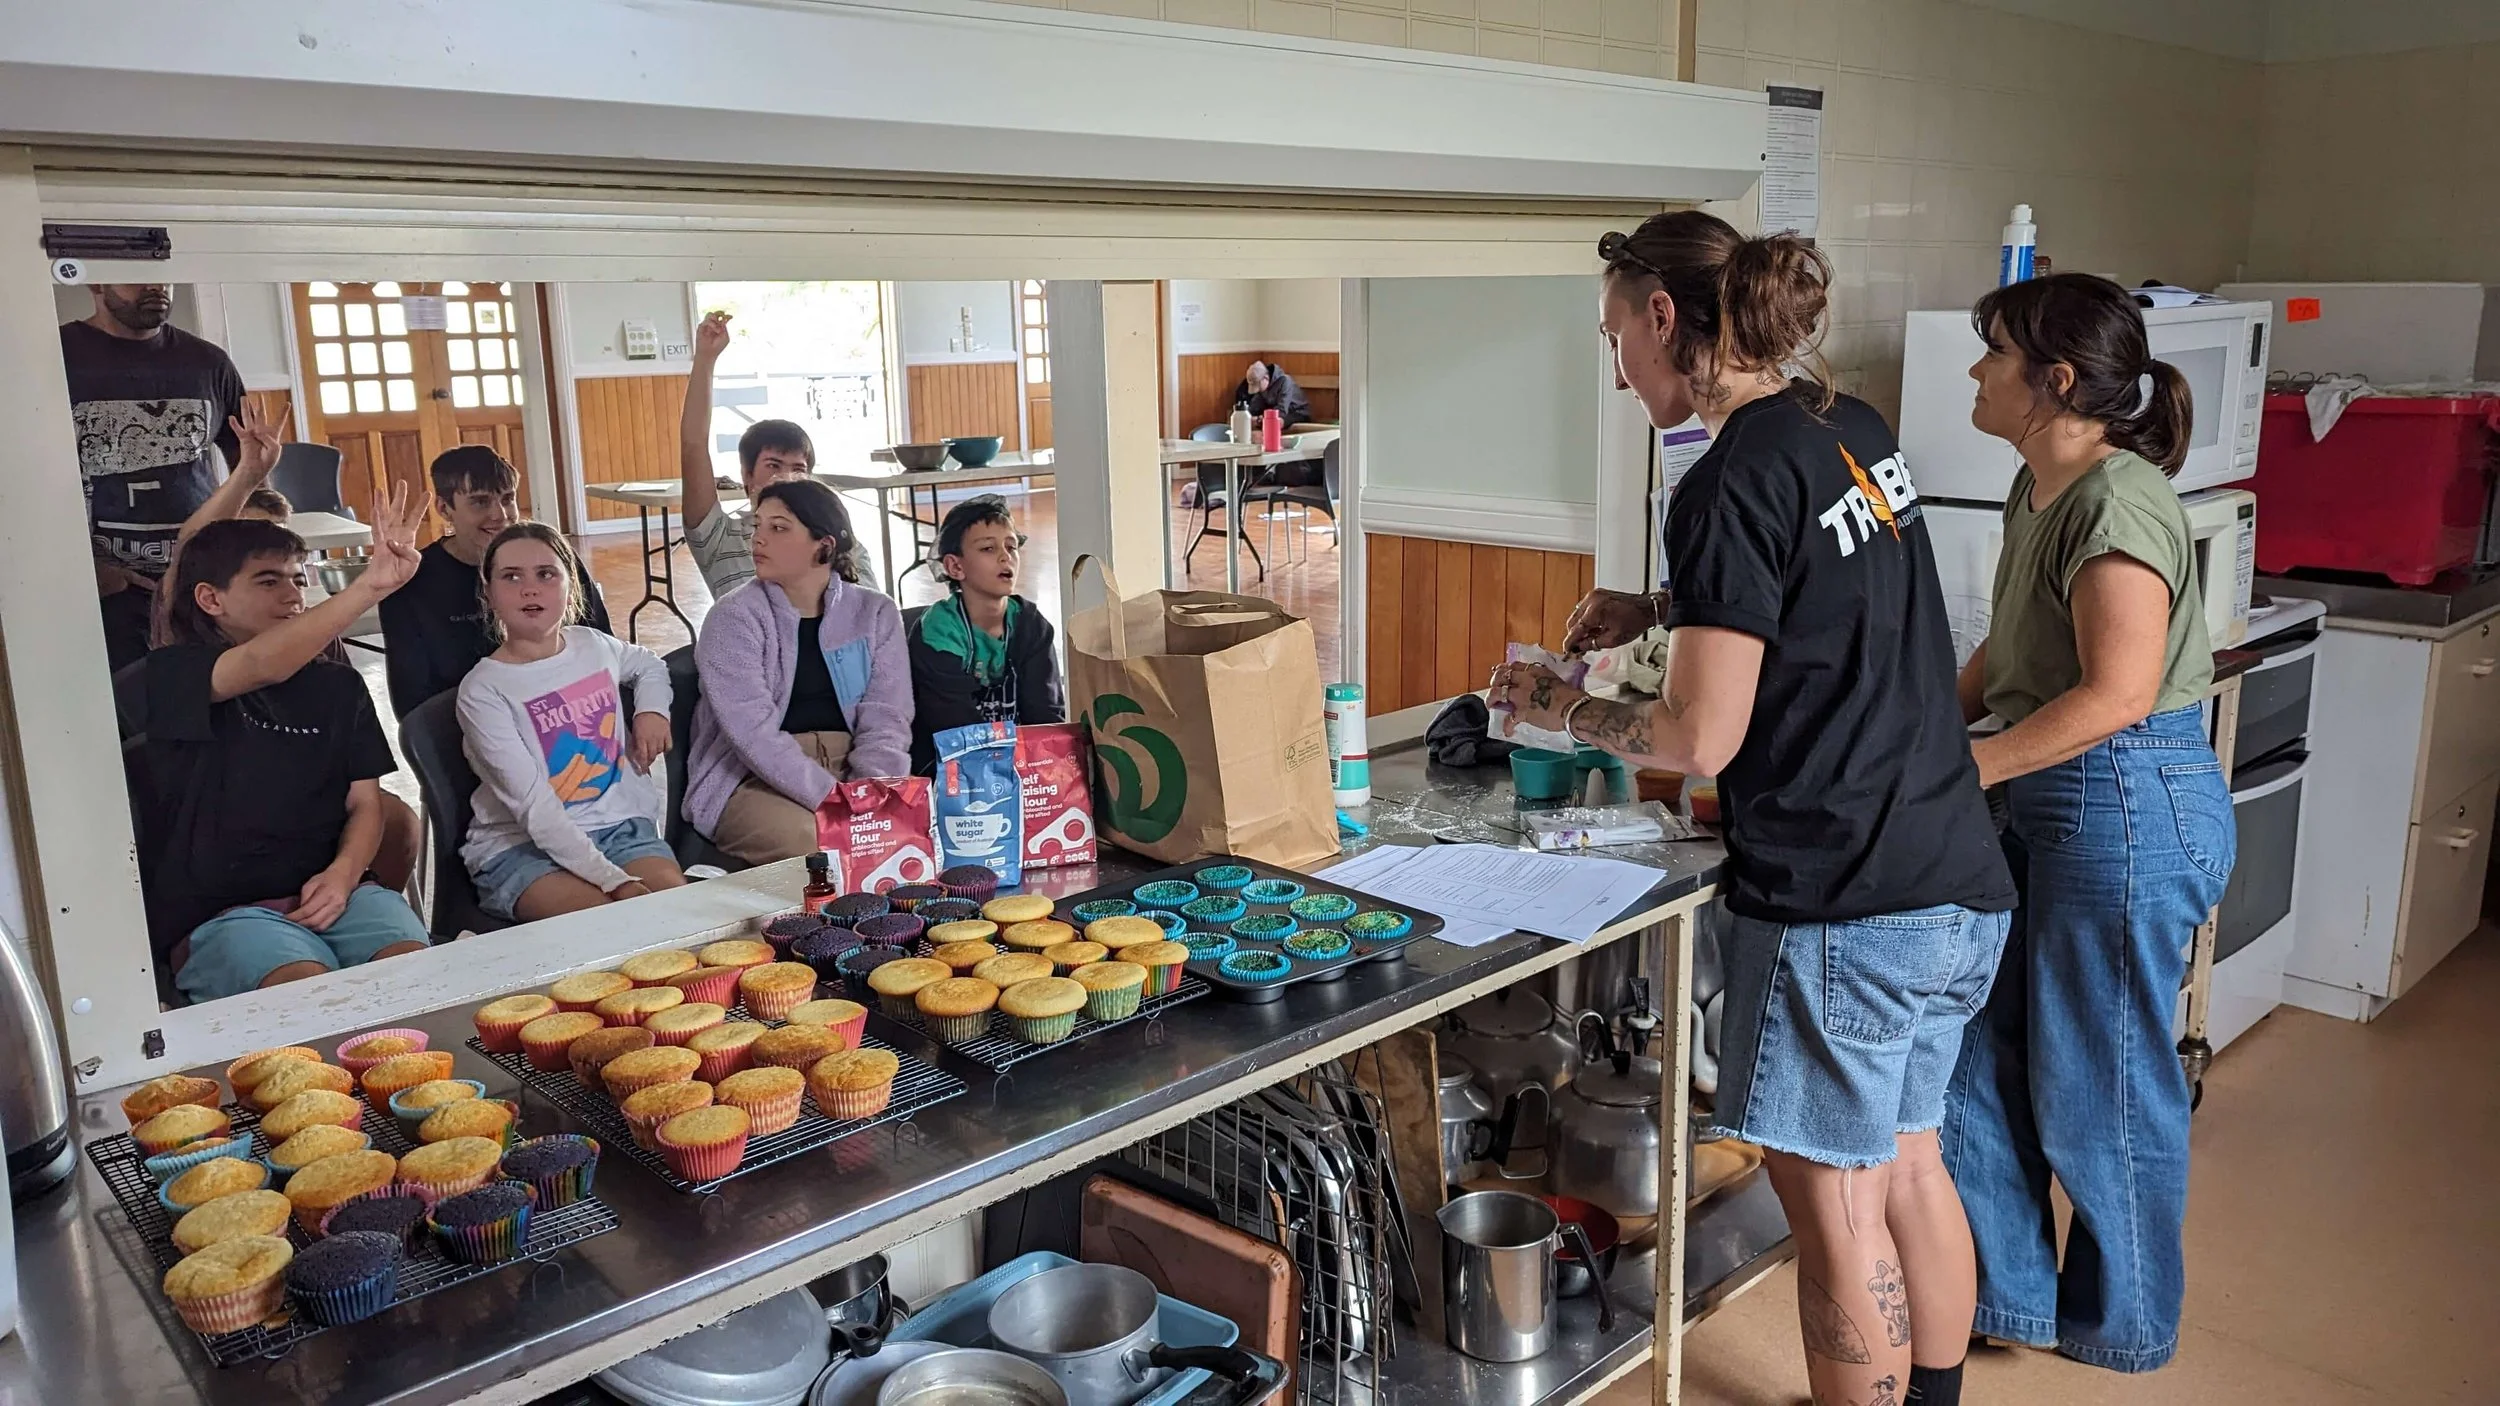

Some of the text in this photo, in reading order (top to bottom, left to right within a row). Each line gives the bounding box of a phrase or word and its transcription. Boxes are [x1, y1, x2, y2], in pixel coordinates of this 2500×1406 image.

[666, 344, 689, 356] EXIT
[1022, 773, 1040, 785] elf
[1022, 784, 1057, 796] aising
[1024, 797, 1048, 807] lour
[850, 819, 891, 833] raising
[955, 819, 984, 828] white
[851, 833, 881, 845] flour
[955, 829, 985, 839] sugar
[850, 841, 885, 852] unbleached
